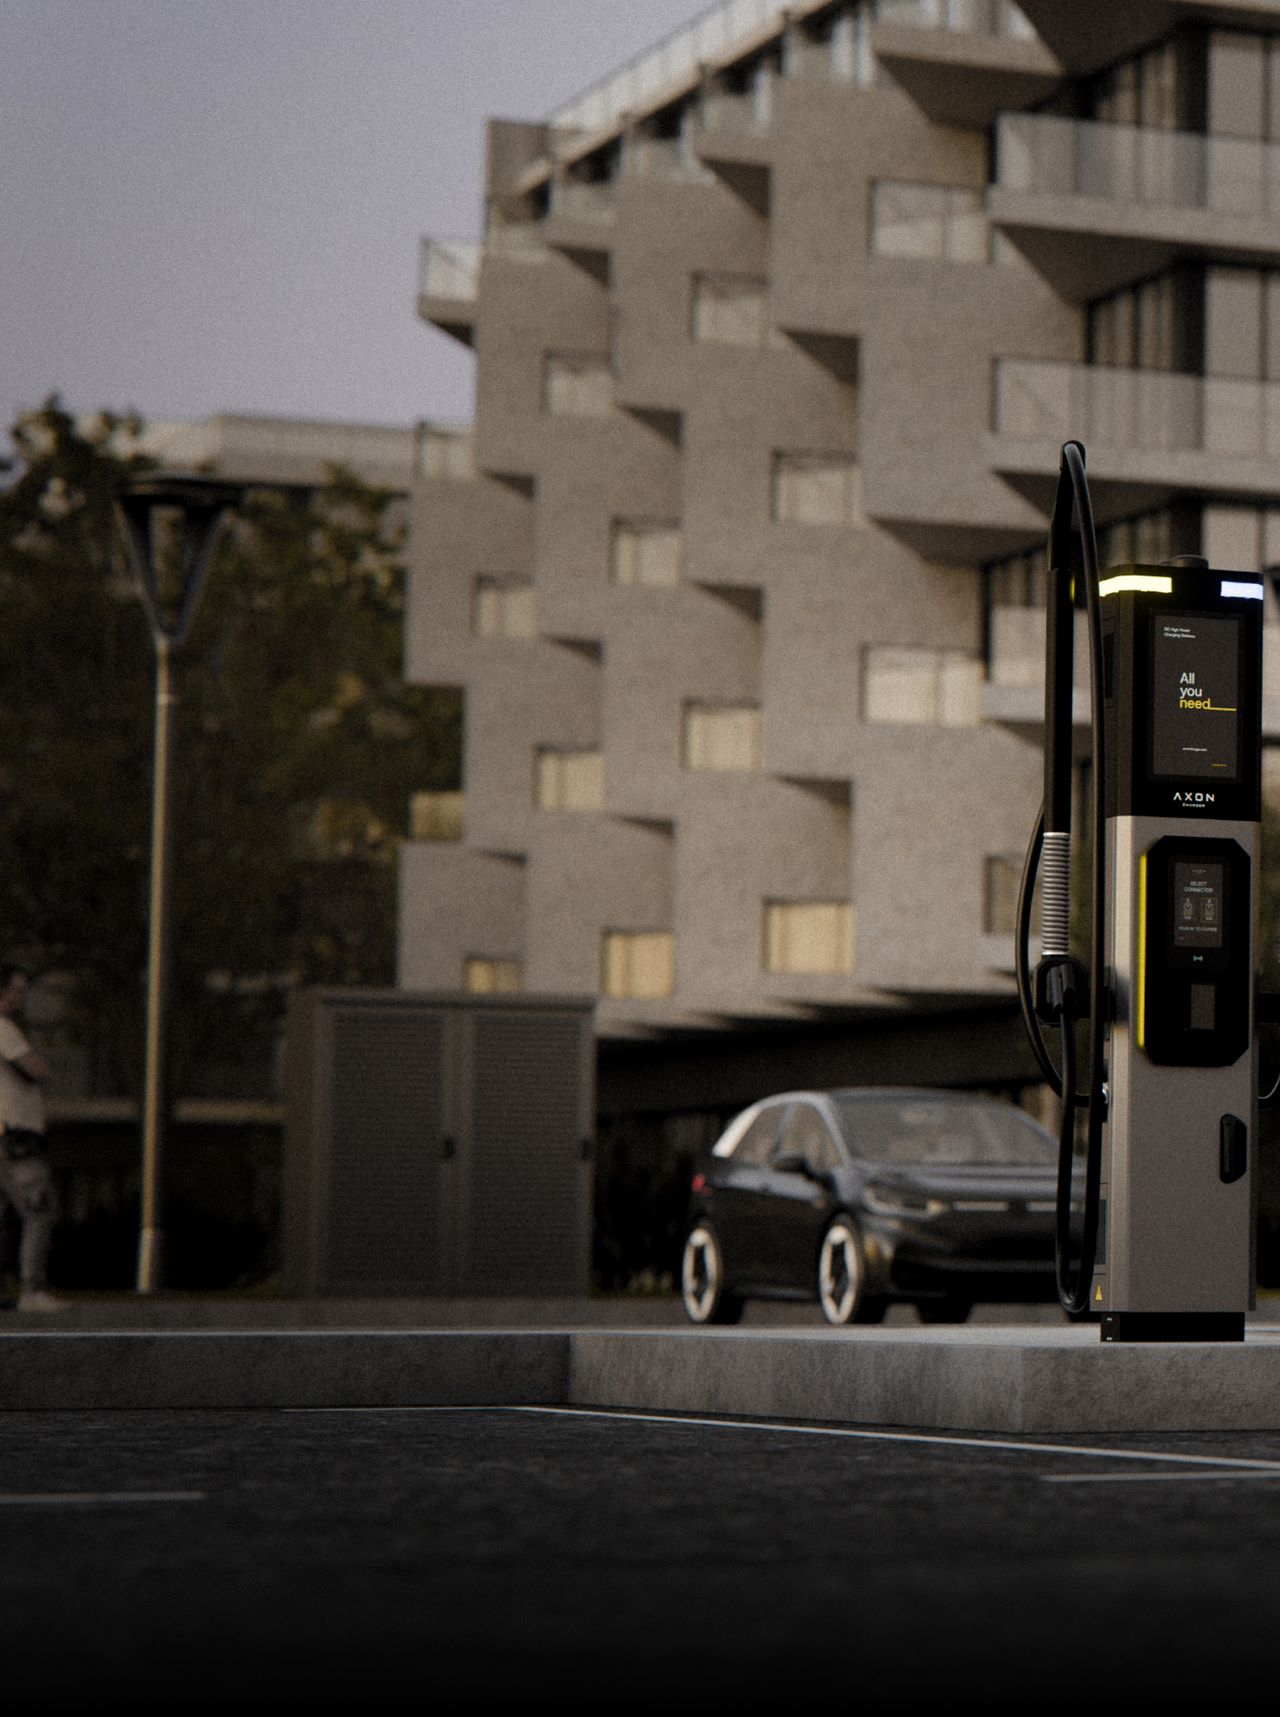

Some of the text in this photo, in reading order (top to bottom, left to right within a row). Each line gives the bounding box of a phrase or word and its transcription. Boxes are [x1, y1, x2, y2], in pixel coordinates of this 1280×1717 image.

[1179, 672, 1195, 685] All
[1179, 687, 1202, 699] you
[1173, 791, 1215, 802] AXON
